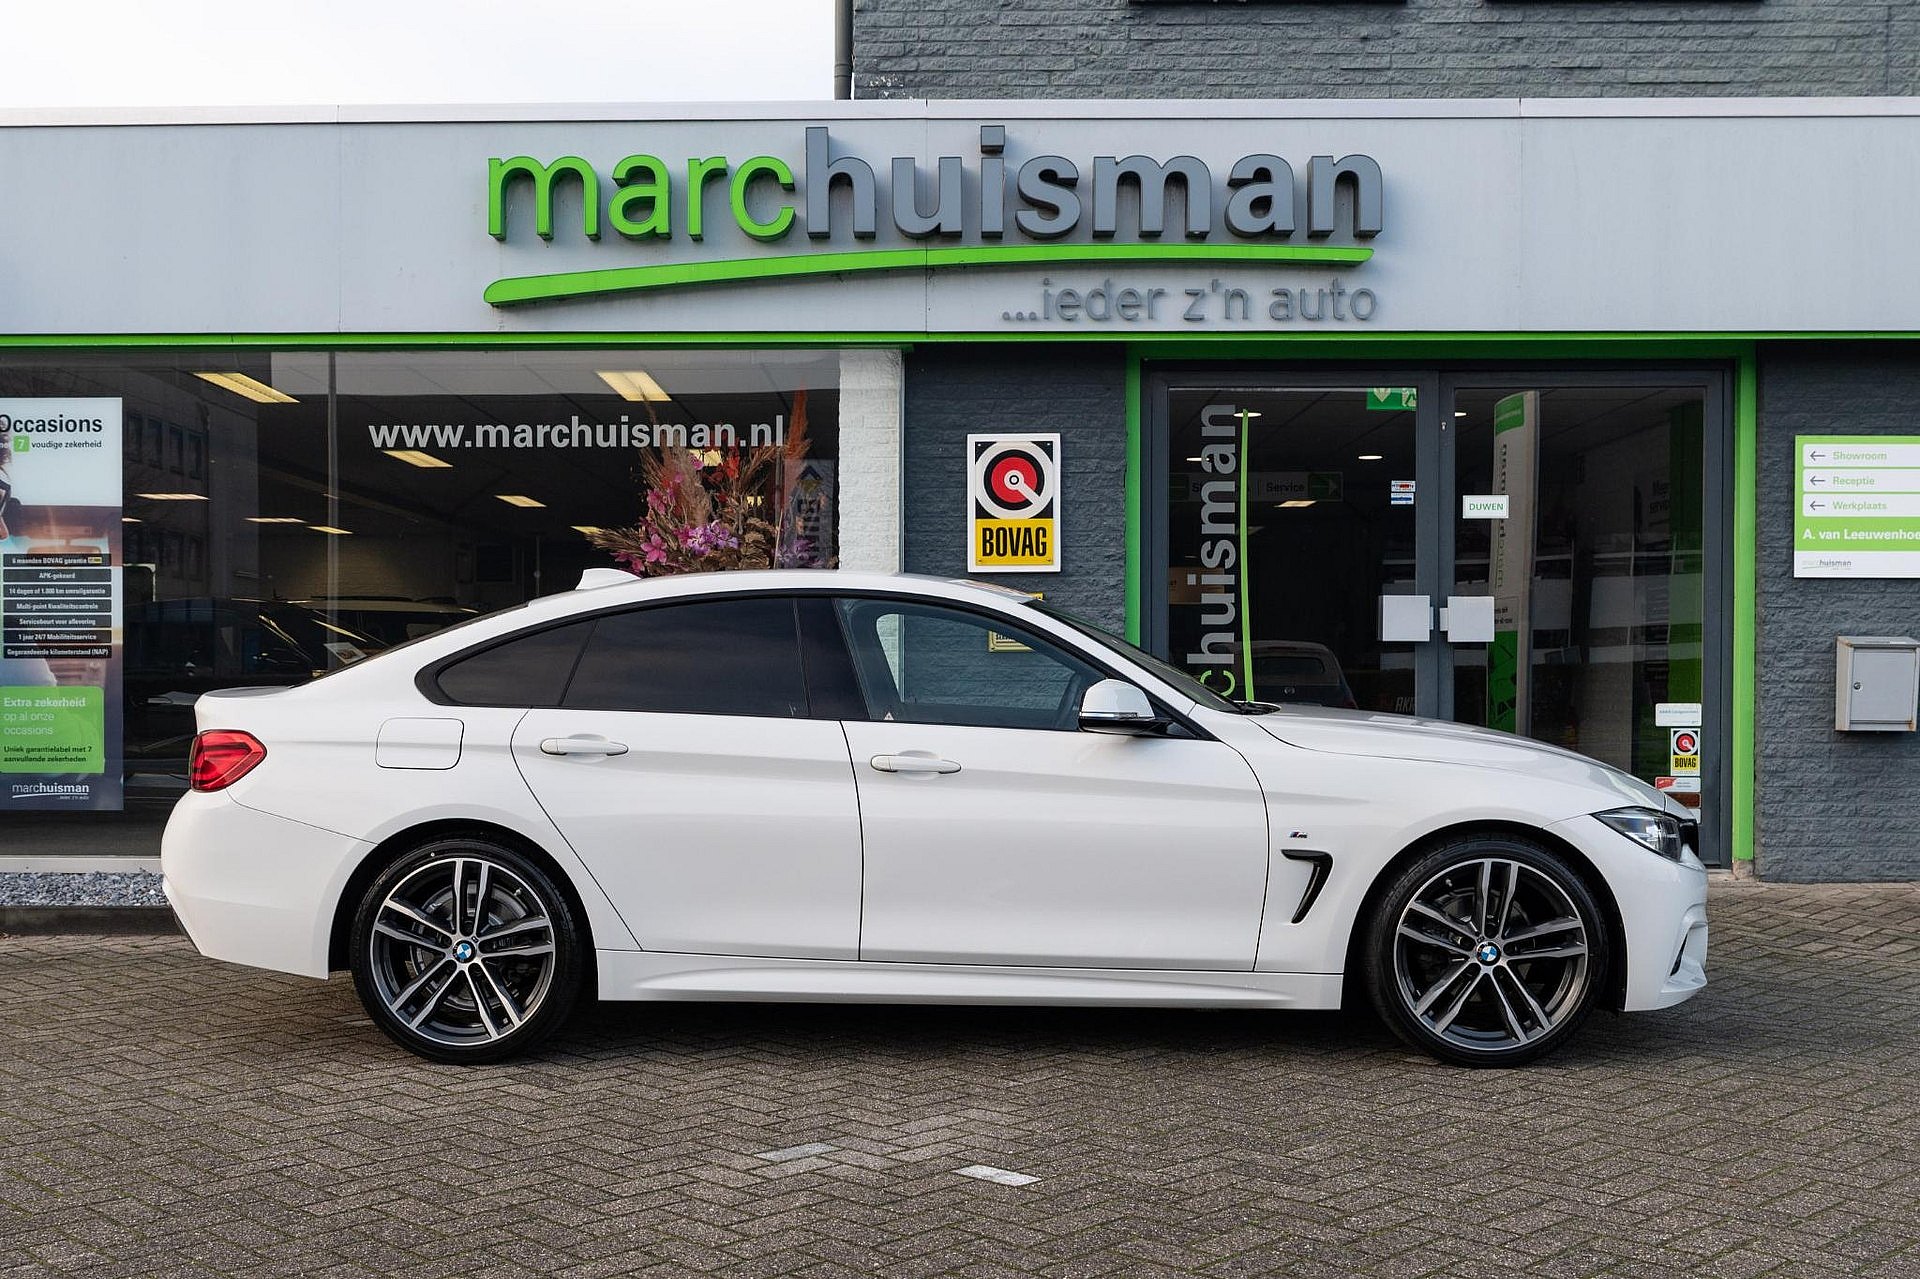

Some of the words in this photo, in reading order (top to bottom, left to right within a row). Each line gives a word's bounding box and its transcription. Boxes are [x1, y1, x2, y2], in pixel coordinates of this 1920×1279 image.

[487, 126, 1383, 241] marchuisman
[1183, 278, 1249, 322] z'n
[1269, 278, 1377, 321] auto
[0, 414, 103, 433] Occasions
[368, 415, 785, 449] www.marchuisman.nl
[31, 440, 63, 450] voudige
[64, 440, 102, 448] zekerheid
[1832, 451, 1888, 461] Showroom
[1266, 481, 1305, 493] Service
[1832, 476, 1875, 487] Receptie
[1469, 503, 1505, 511] DUWEN
[1832, 501, 1888, 511] Werkplaats
[1803, 528, 1816, 540] A.
[1819, 530, 1841, 540] van
[981, 526, 1048, 557] BOVAG
[3, 697, 32, 707] Extra
[35, 697, 86, 707] zekerheid
[3, 713, 17, 722] op
[20, 711, 28, 721] al
[31, 713, 55, 721] onze
[3, 727, 54, 735] occasions
[3, 745, 24, 753] Uniek
[25, 745, 71, 754] garantielabel
[1674, 757, 1697, 768] BOVAG
[11, 782, 90, 793] marchuisman
